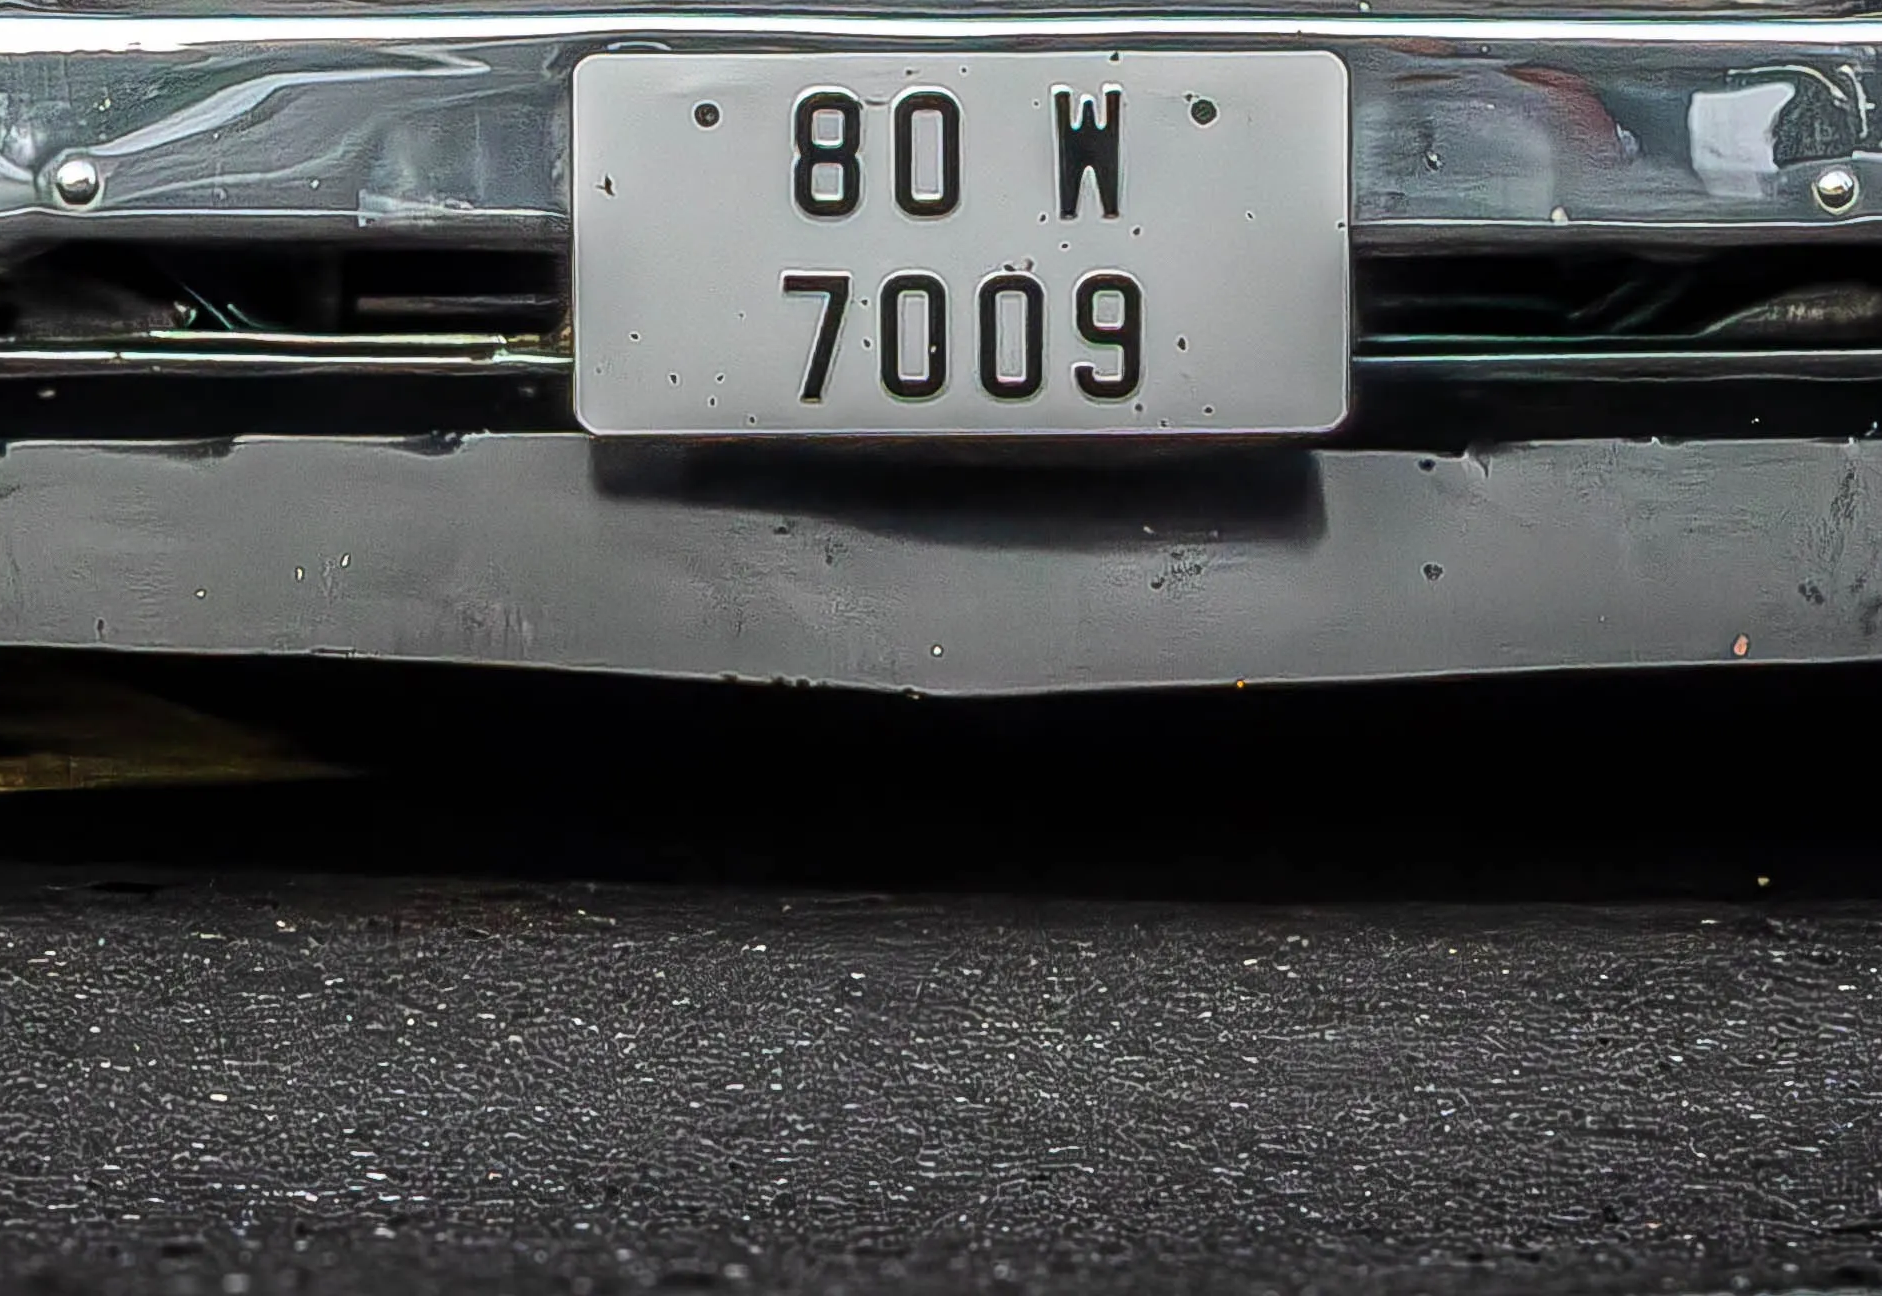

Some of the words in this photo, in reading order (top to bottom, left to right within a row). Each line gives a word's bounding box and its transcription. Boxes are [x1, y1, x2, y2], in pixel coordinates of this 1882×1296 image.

[792, 90, 962, 219] 80
[1052, 87, 1123, 220] W
[780, 272, 1143, 404] 7009
